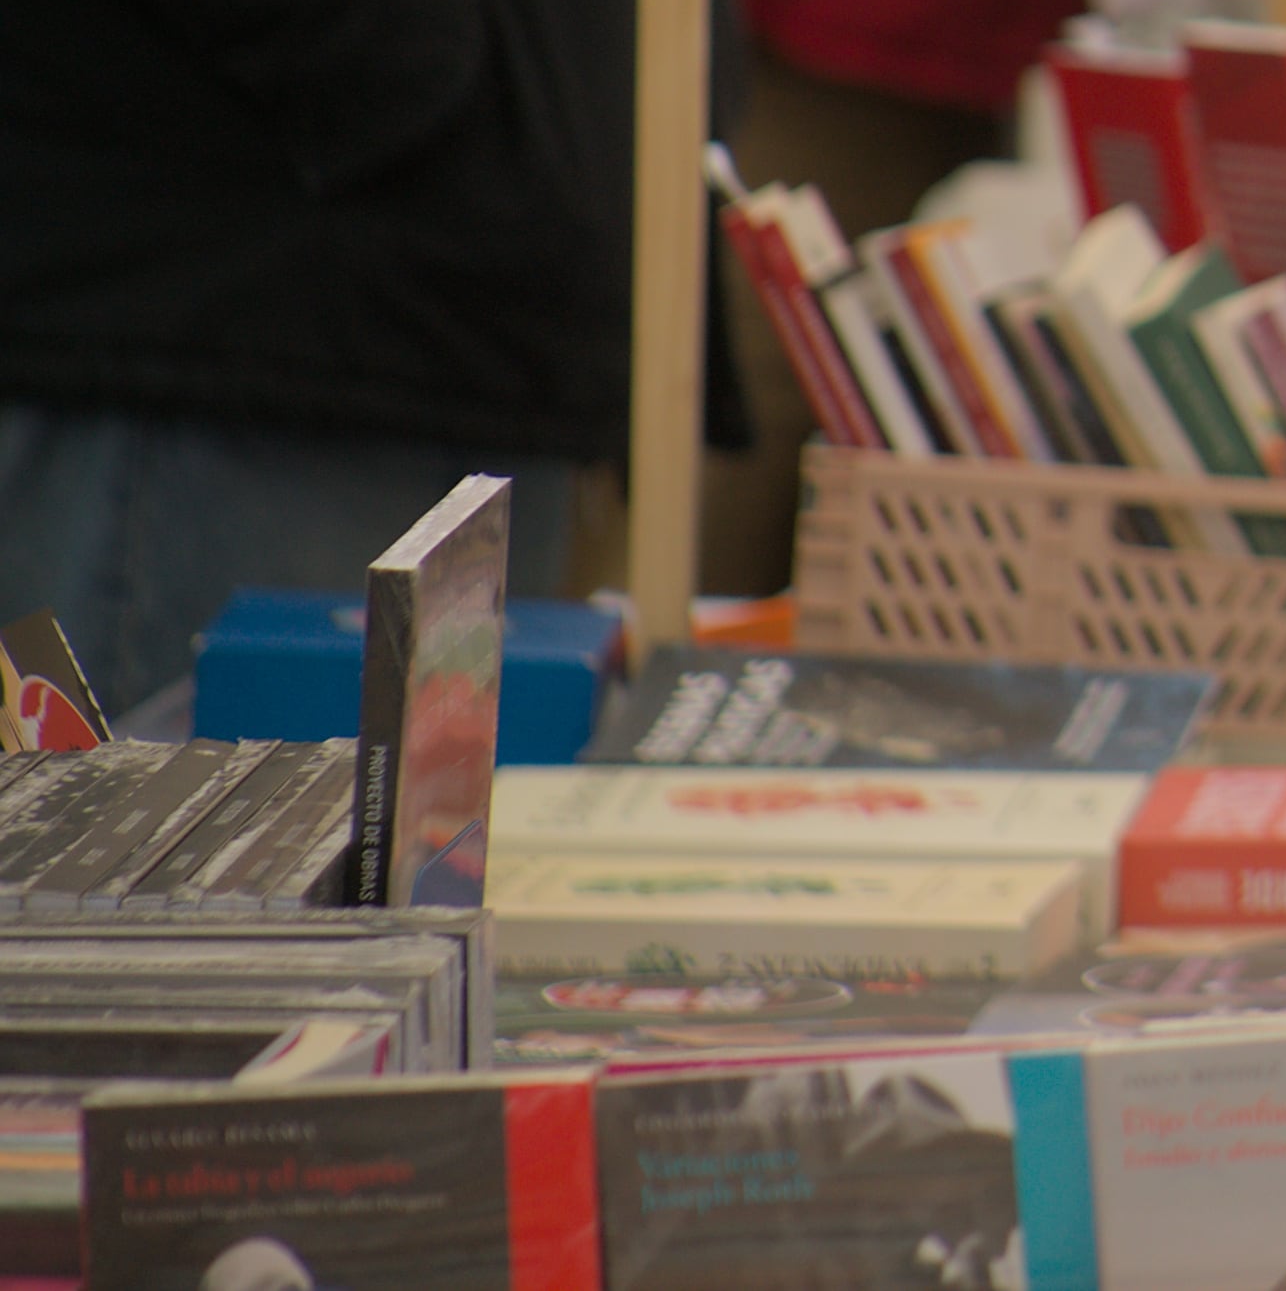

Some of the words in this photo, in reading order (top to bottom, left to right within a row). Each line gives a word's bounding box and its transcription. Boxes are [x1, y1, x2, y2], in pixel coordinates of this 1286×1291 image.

[364, 744, 388, 822] PROYECTO
[362, 825, 382, 847] DE
[357, 848, 381, 901] OBRAS
